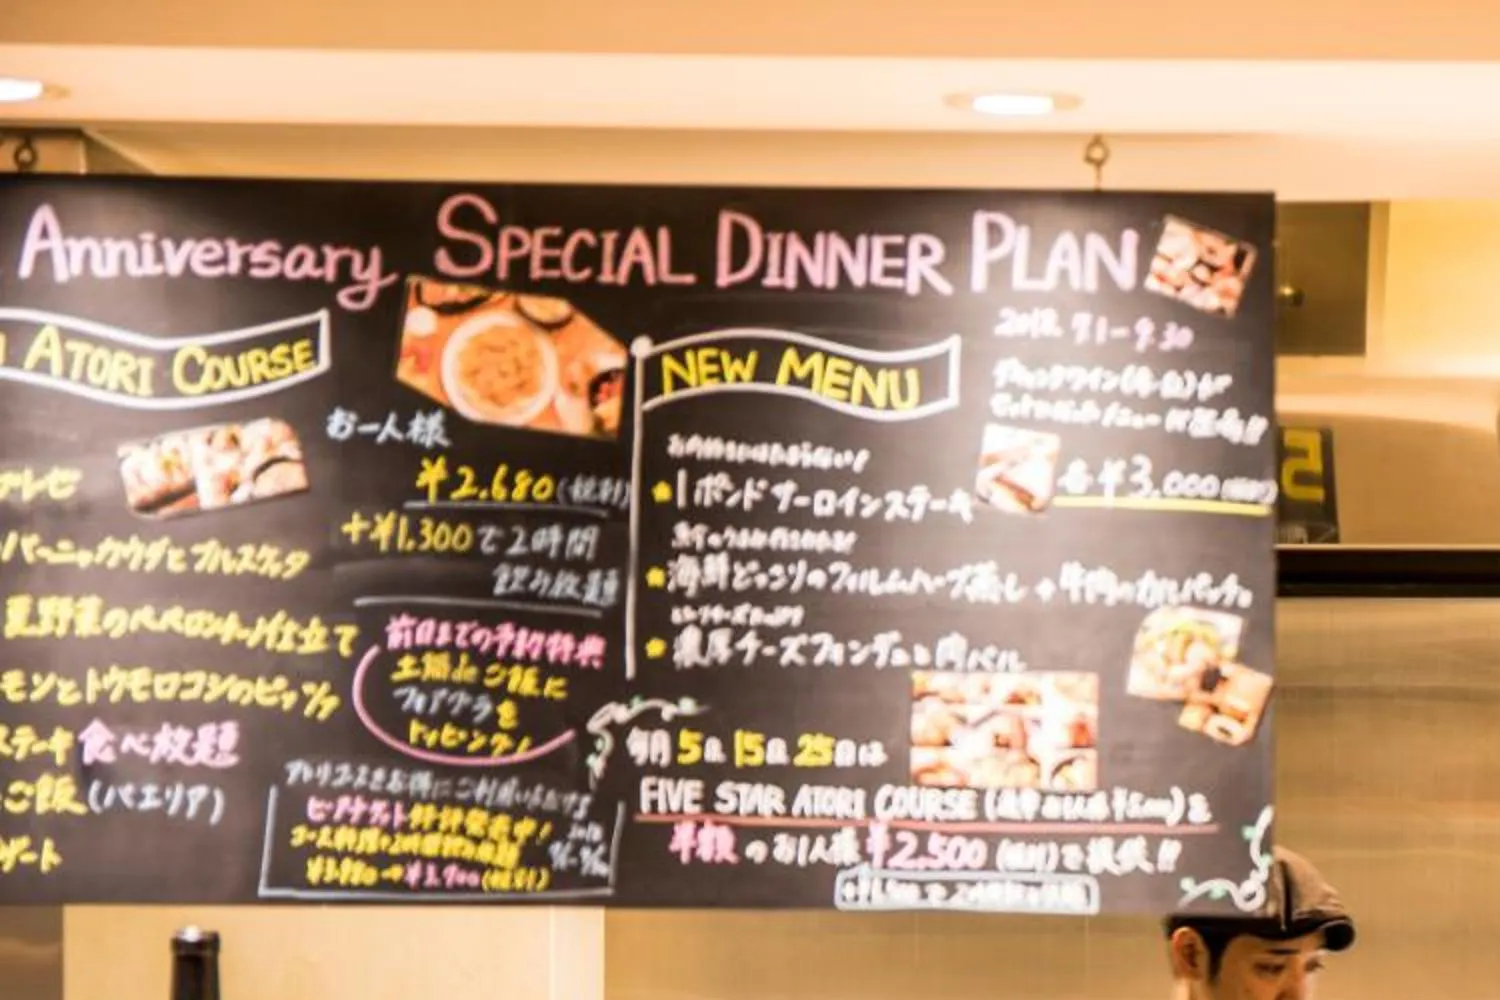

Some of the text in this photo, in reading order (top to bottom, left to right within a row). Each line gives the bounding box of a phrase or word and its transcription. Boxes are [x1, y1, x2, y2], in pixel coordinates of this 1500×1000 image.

[18, 193, 1139, 312] Anniversary SPECIAL DINNER PLAN
[23, 324, 154, 396] ATORI
[171, 343, 319, 396] COURSE
[660, 347, 921, 411] NEW MENU
[325, 405, 453, 449] お一人様
[638, 775, 706, 815] FIVE
[712, 779, 788, 821] STAR
[873, 782, 979, 822] COURSE
